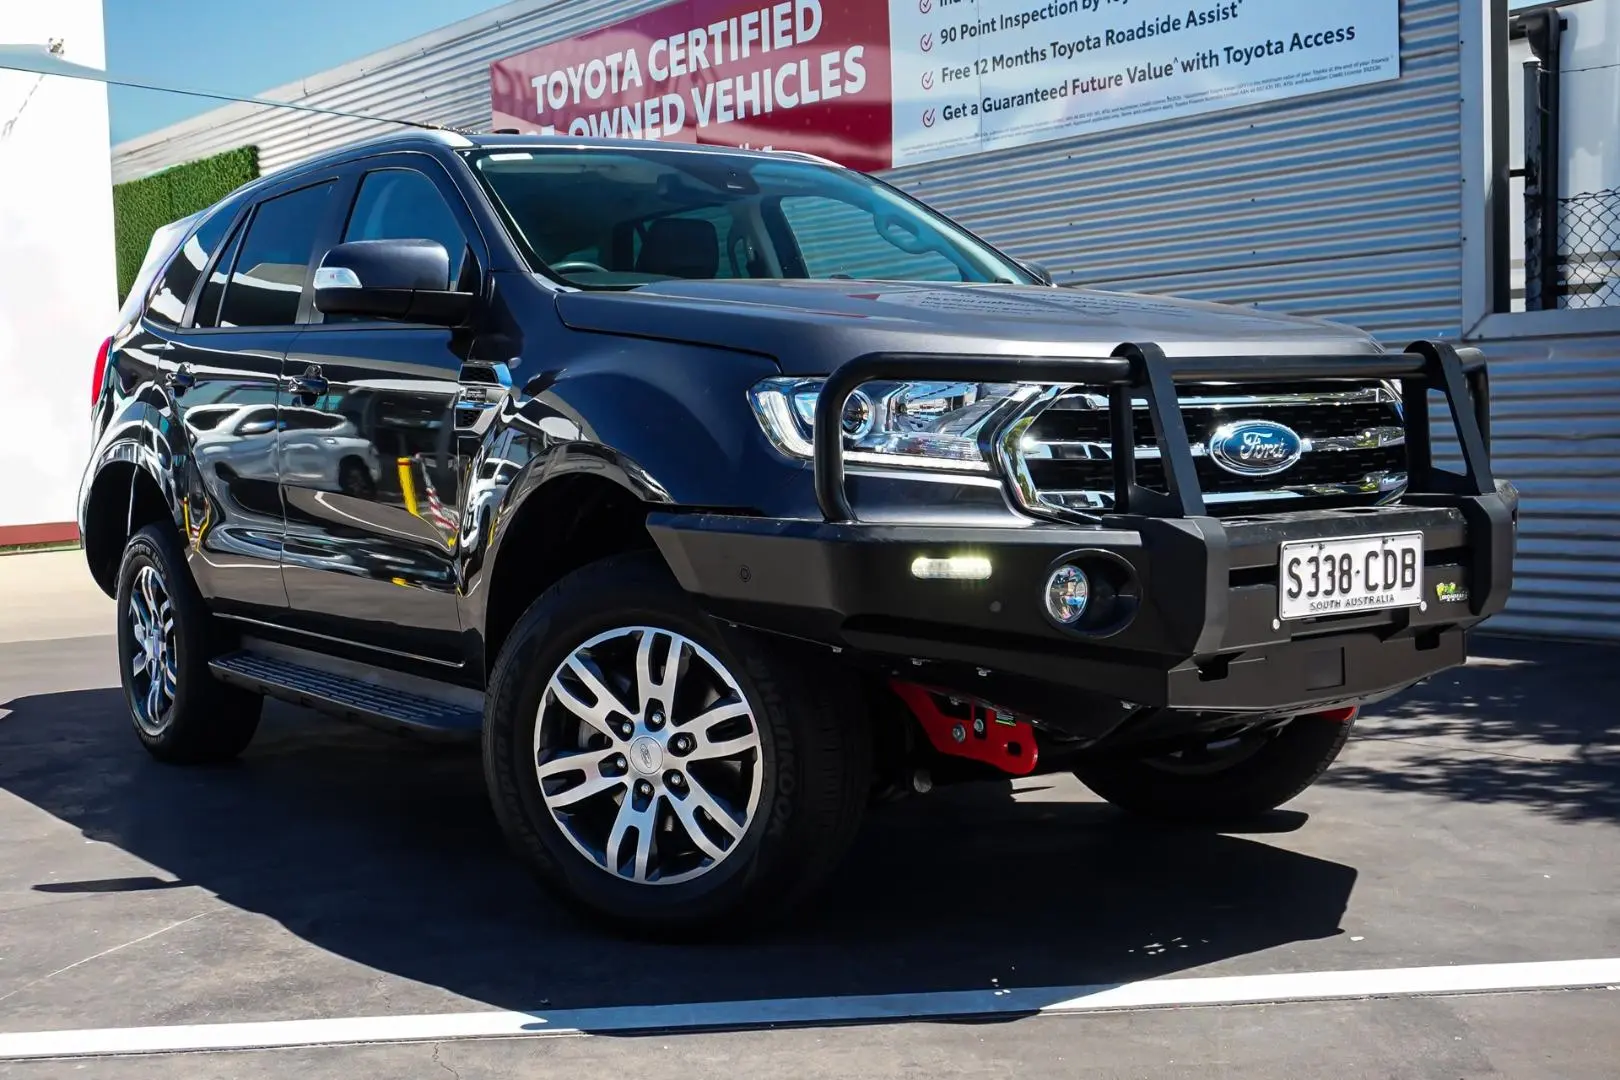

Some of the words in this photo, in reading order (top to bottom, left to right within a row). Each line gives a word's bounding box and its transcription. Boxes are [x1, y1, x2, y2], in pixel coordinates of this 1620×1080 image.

[531, 48, 644, 114] TOYOTA
[648, 0, 823, 82] CERTIFIED
[940, 26, 957, 45] 90
[961, 17, 997, 40] Point
[1000, 0, 1078, 30] Inspection
[941, 63, 971, 84] Free
[973, 58, 988, 76] 12
[992, 46, 1048, 72] Months
[1050, 34, 1102, 60] Toyota
[1105, 14, 1182, 47] Roadside
[691, 45, 866, 128] VEHICLES
[943, 101, 968, 121] Get
[971, 103, 979, 116] a
[982, 80, 1069, 113] Guaranteed
[1072, 72, 1123, 96] Future
[1181, 50, 1219, 73] with
[1223, 38, 1284, 66] Toyota
[1289, 25, 1356, 52] Access
[1240, 431, 1288, 460] Ford
[1309, 599, 1342, 612] SOUTH
[1345, 594, 1395, 609] AUSTRALIA
